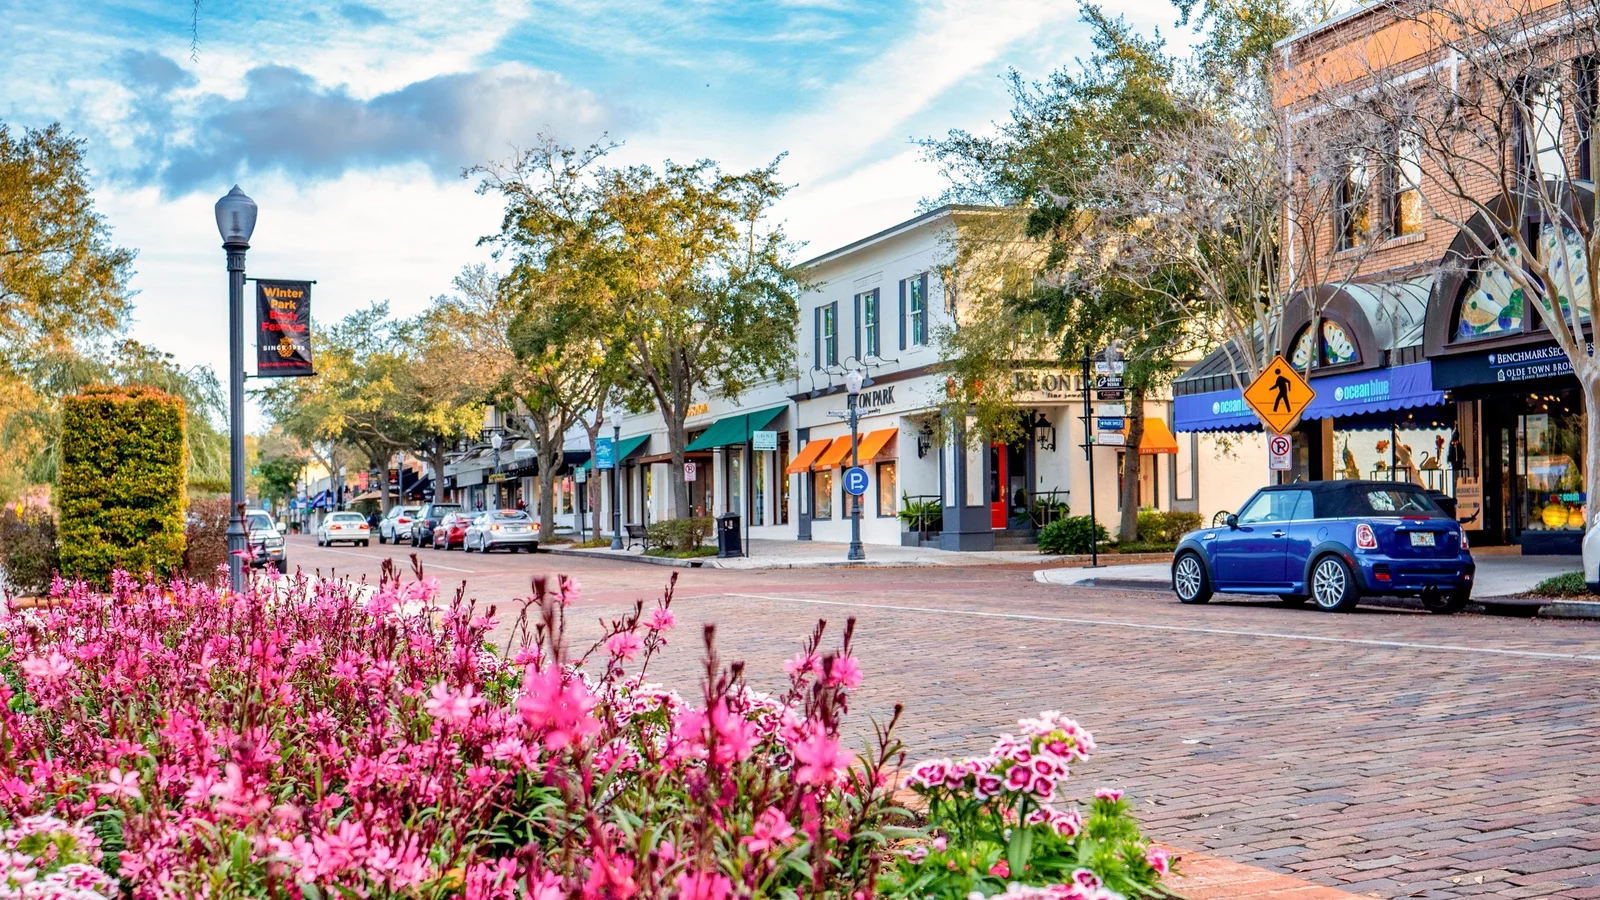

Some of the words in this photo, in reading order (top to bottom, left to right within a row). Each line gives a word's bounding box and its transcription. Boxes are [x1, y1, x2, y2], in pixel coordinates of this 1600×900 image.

[263, 287, 303, 298] Winter
[270, 299, 296, 310] Park
[269, 310, 297, 321] Bach
[262, 322, 305, 332] Festival
[1497, 349, 1548, 364] BENCHMARK
[1506, 367, 1526, 378] OLDE
[1527, 364, 1551, 375] TOWN
[1041, 374, 1071, 392] ON
[1344, 383, 1370, 400] ocean
[1370, 378, 1389, 396] blue
[858, 391, 872, 408] ON
[872, 385, 895, 407] PARK
[1363, 395, 1390, 403] GALLERIES
[1220, 399, 1242, 414] ocean
